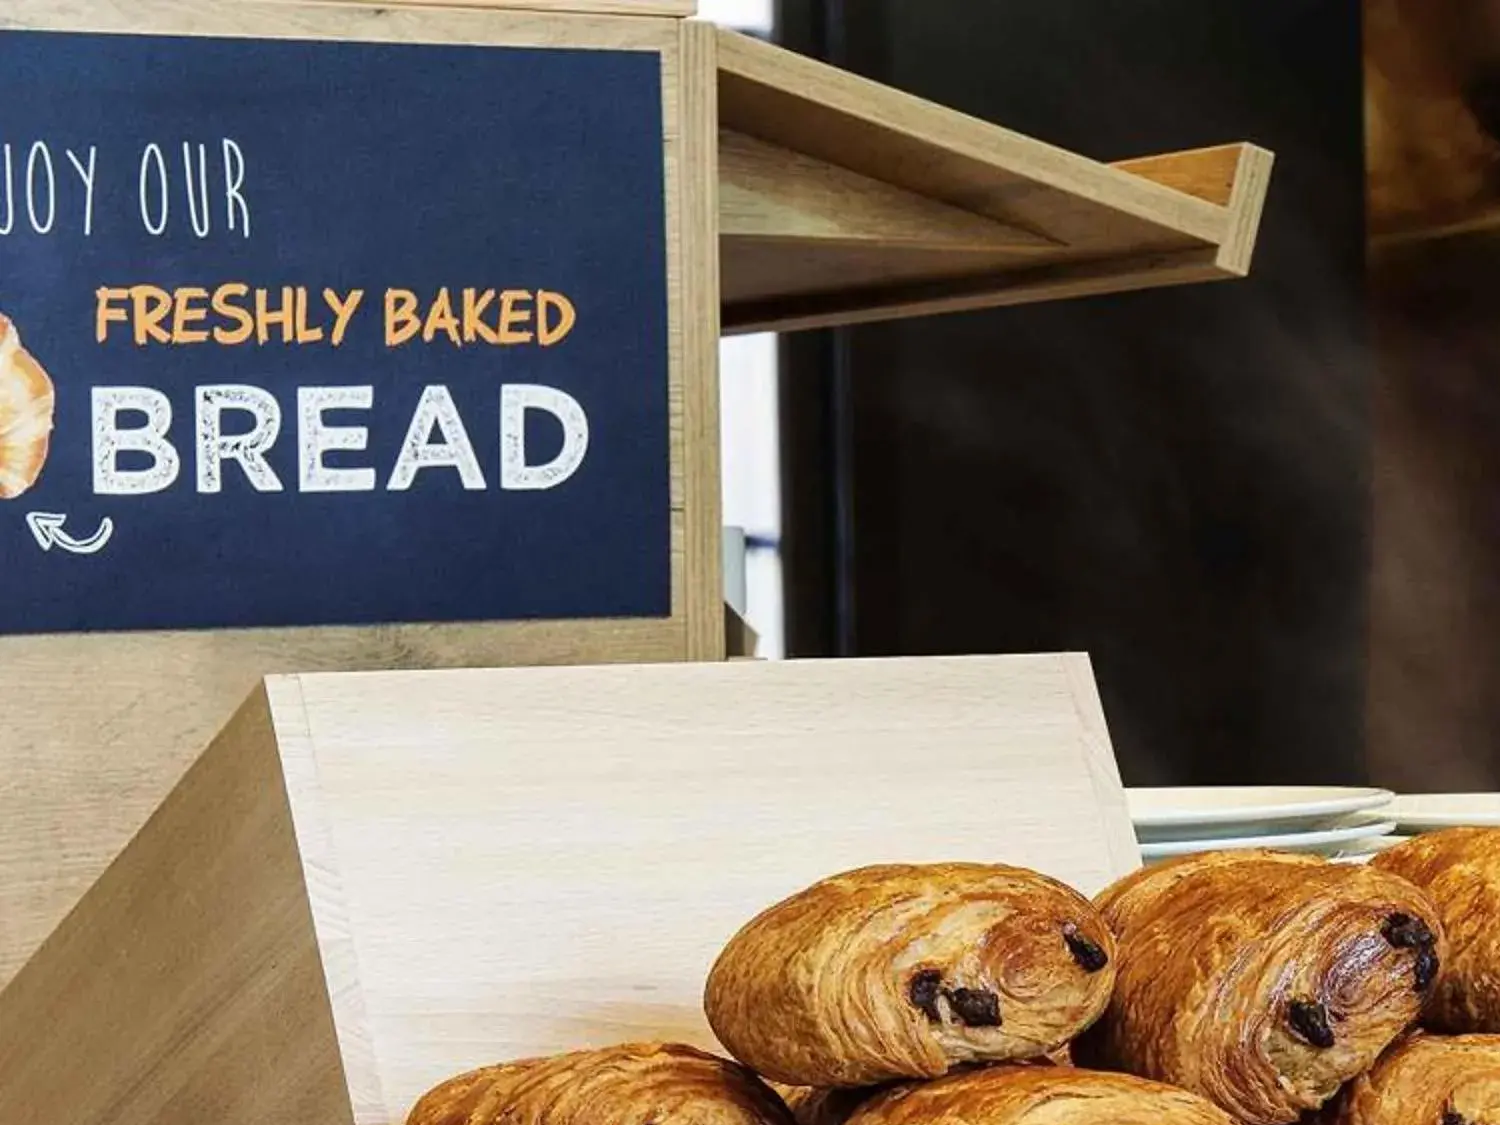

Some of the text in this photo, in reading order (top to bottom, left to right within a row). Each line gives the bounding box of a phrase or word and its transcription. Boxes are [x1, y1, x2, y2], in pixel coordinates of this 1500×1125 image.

[0, 138, 250, 238] JOY OUR
[95, 283, 576, 346] FRESHLY BAKED
[91, 383, 589, 494] BREAD
